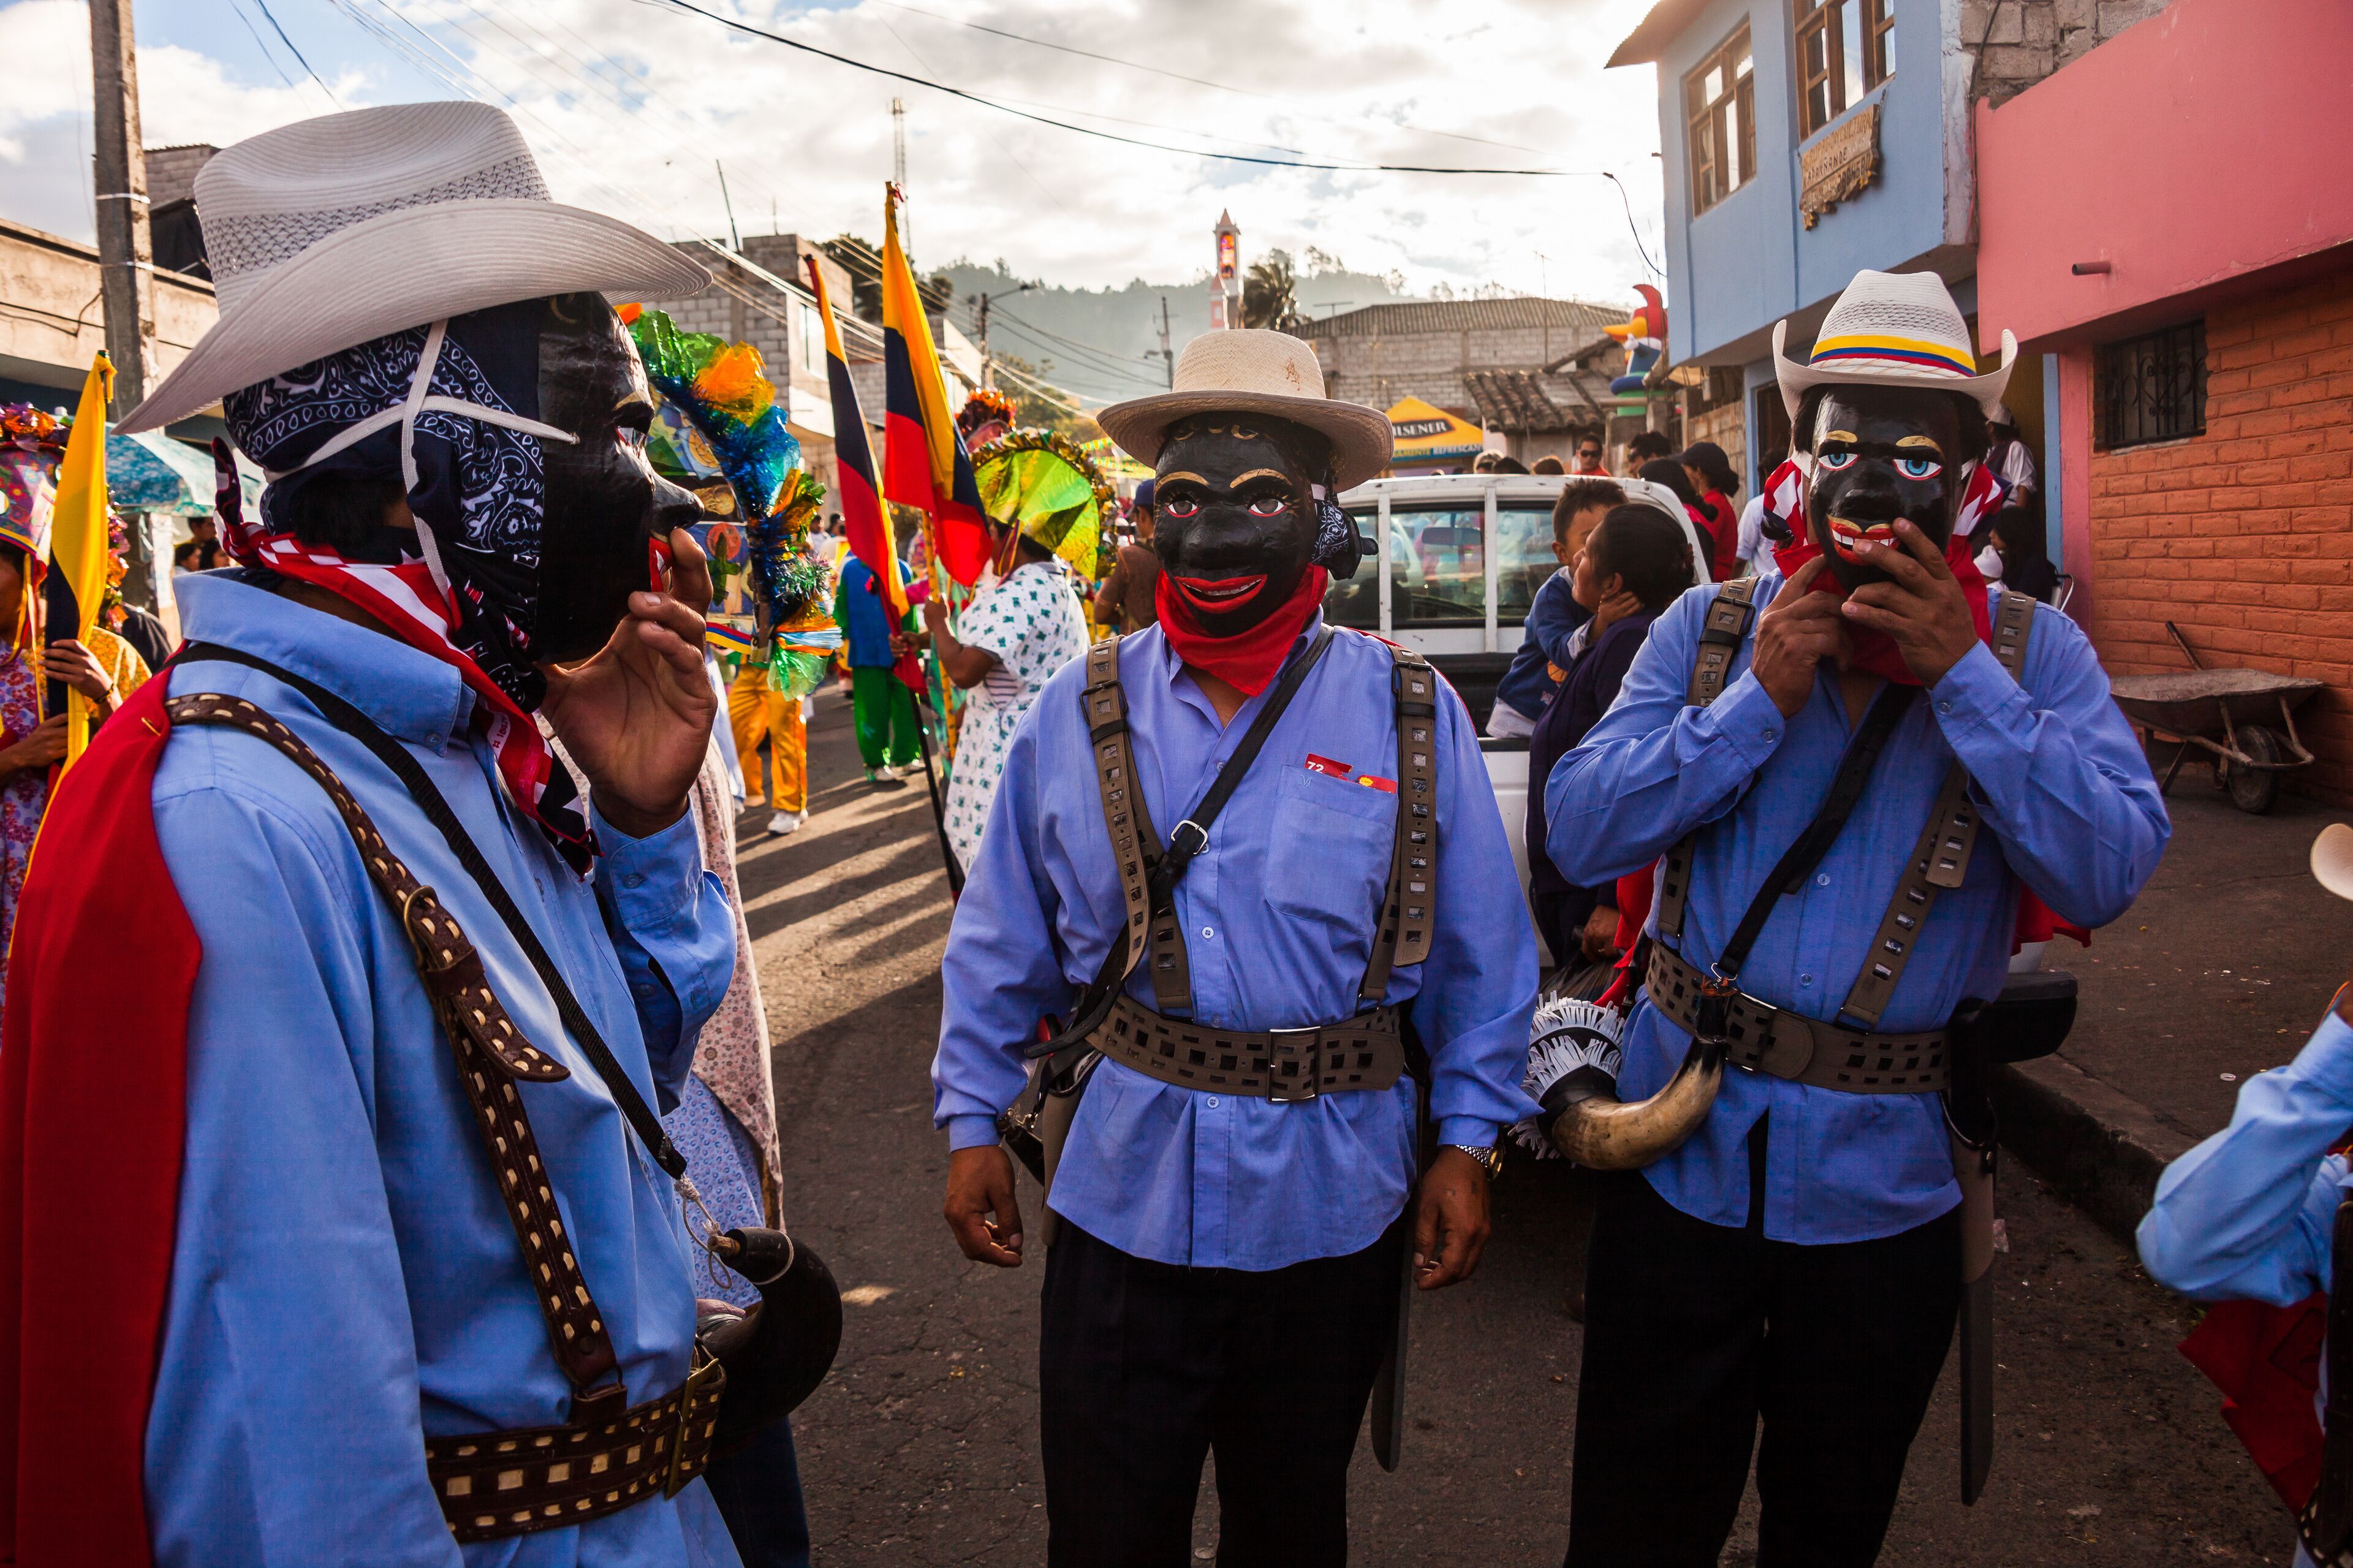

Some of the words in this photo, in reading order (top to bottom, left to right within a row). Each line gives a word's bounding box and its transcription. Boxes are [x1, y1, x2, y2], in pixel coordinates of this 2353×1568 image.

[1392, 421, 1447, 437] ILSENER
[1307, 760, 1324, 774] 72
[1300, 775, 1313, 787] M
